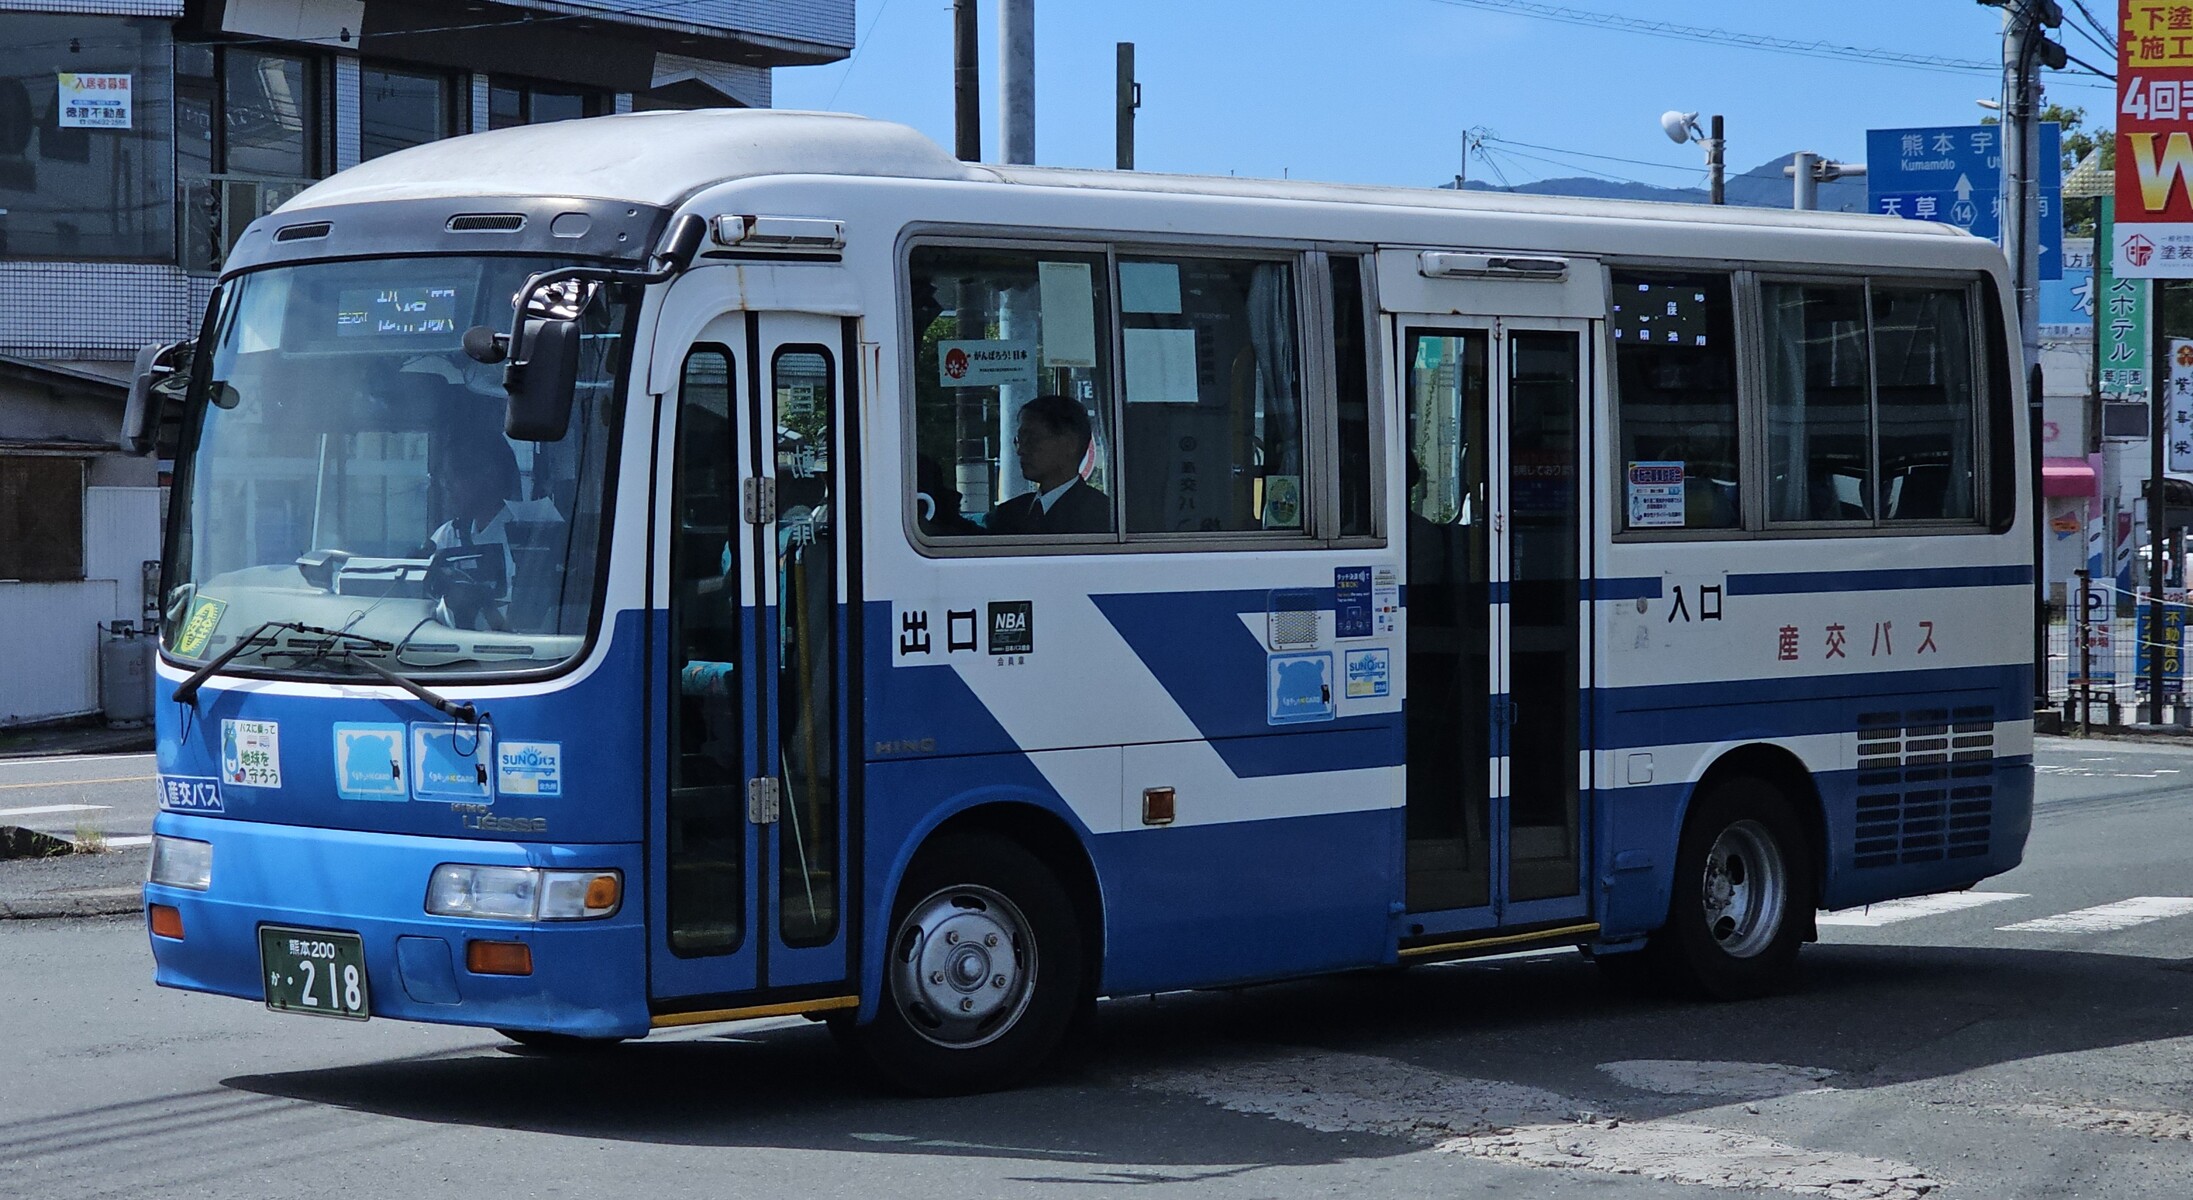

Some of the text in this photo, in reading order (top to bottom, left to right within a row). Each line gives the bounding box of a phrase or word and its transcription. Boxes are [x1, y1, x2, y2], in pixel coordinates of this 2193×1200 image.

[75, 77, 128, 90] 入居者募集
[1901, 131, 1993, 157] 熊本 宇
[1901, 156, 2001, 171] Kumamoto Ut
[1881, 196, 1937, 220] 天草
[1955, 206, 1972, 221] 14
[1668, 584, 1722, 623] 入口
[995, 612, 1026, 629] NBA
[900, 608, 977, 656] 出口
[1778, 621, 1937, 661] 産交バス
[240, 723, 276, 735] バスに乗って
[241, 750, 270, 767] 地球を
[248, 767, 279, 785] 守ろう
[167, 781, 221, 807] 産交バス
